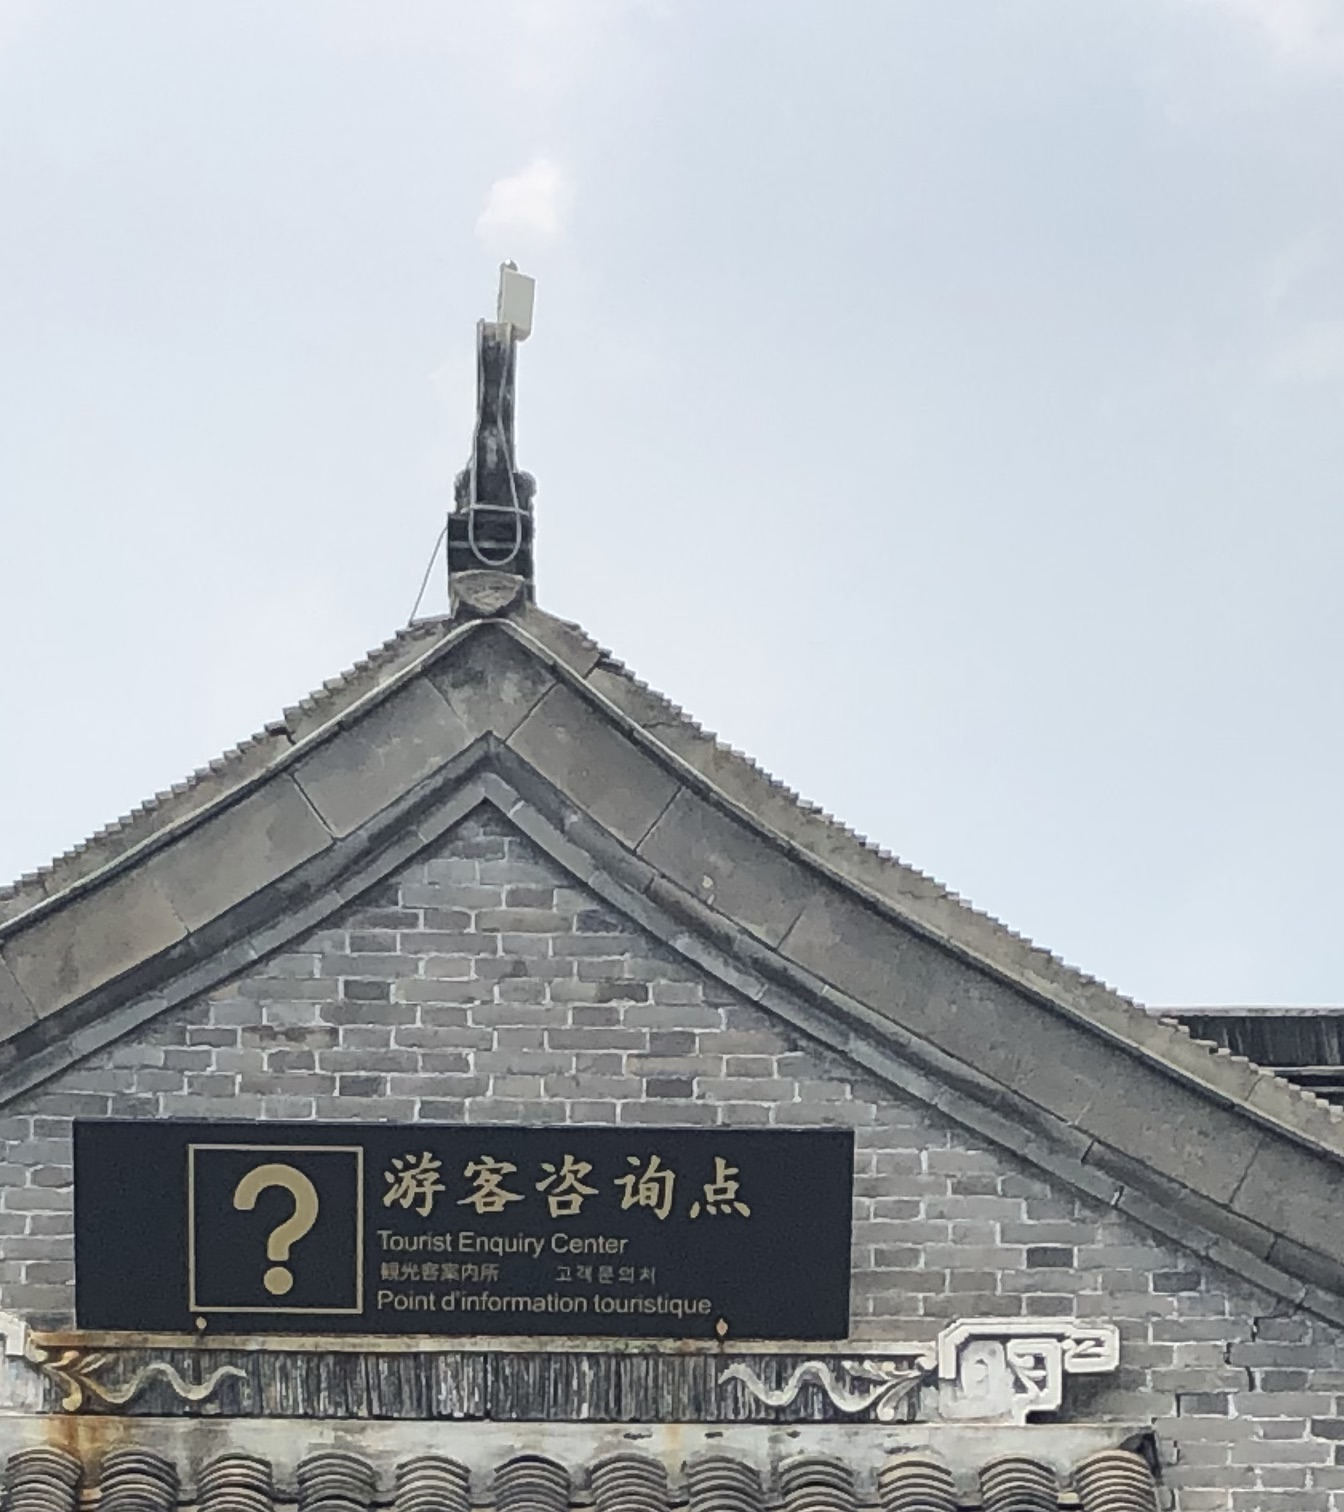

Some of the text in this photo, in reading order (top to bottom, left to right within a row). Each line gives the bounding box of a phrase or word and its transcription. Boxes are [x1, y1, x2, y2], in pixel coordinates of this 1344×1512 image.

[383, 1151, 751, 1221] 游客咨询点
[377, 1230, 629, 1259] Tourist Enquiry Center
[376, 1289, 713, 1320] Point d'information touristique
